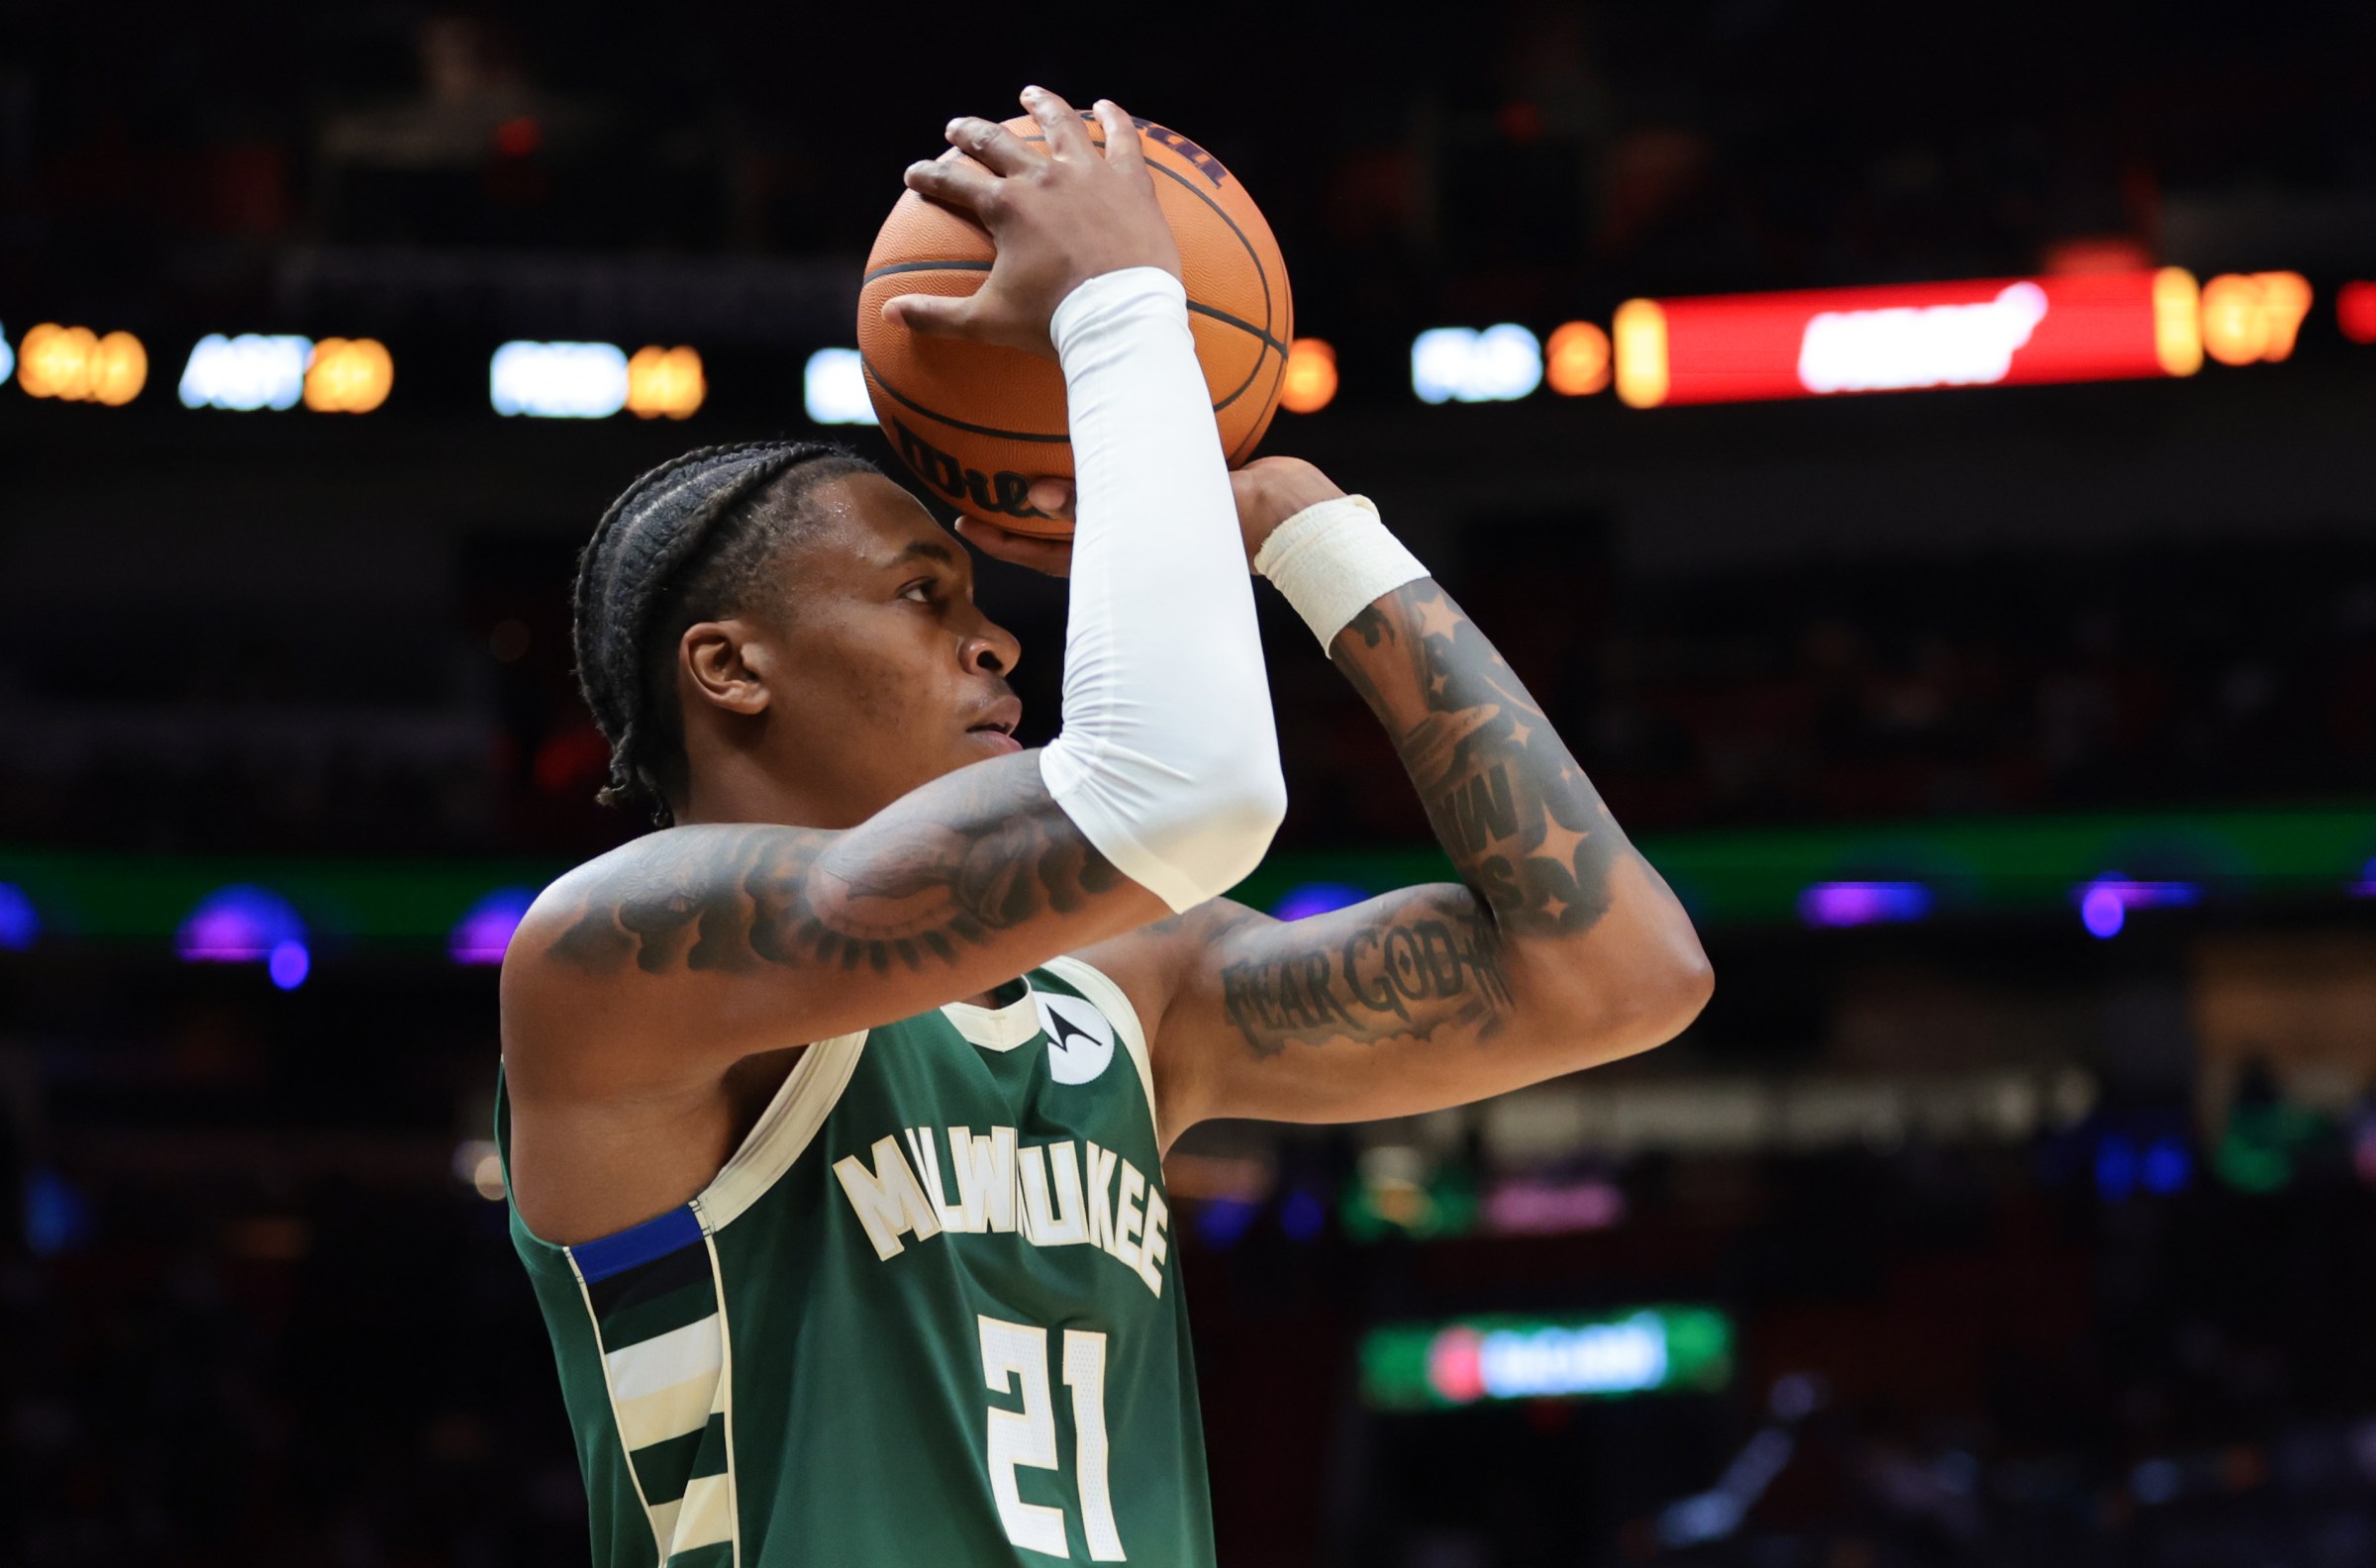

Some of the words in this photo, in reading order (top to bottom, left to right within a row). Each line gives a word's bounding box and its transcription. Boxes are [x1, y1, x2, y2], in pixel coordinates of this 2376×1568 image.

[1222, 950, 1367, 1053] FEAR
[1343, 919, 1465, 1023] GOD
[832, 1125, 1169, 1299] MILWUKEE
[977, 1314, 1127, 1561] 21
